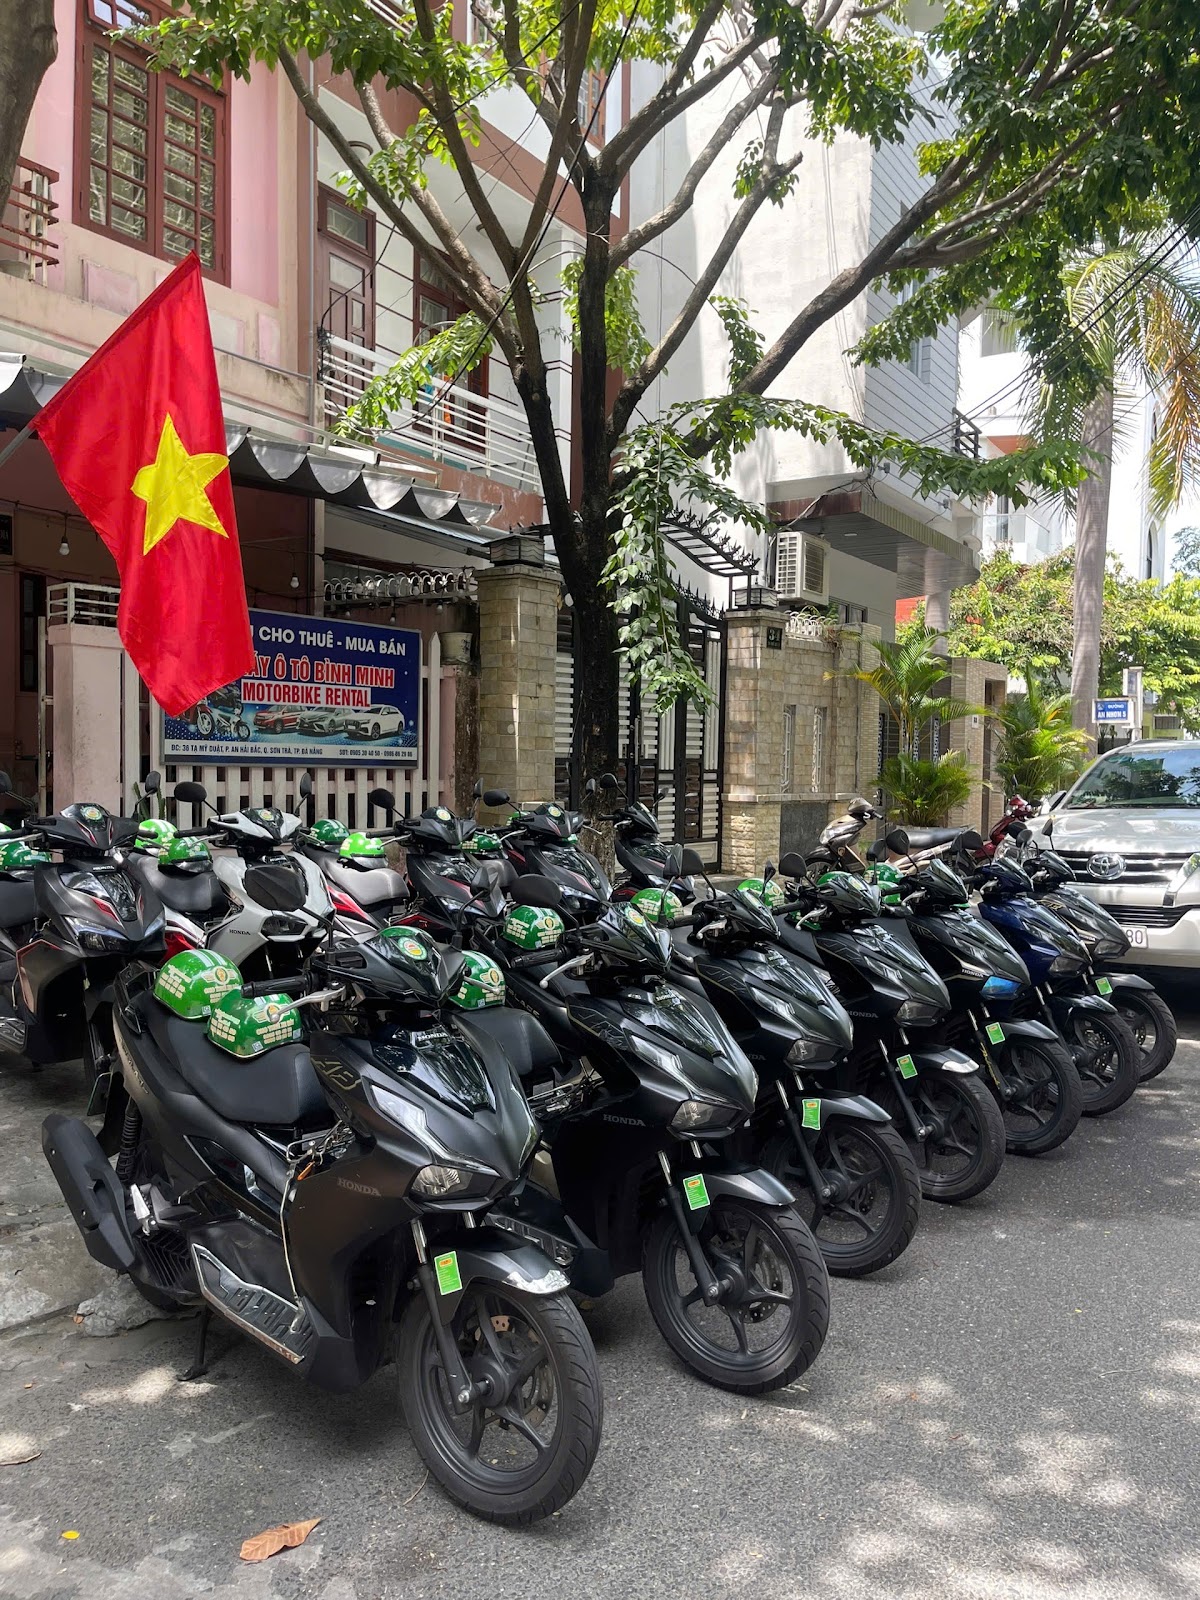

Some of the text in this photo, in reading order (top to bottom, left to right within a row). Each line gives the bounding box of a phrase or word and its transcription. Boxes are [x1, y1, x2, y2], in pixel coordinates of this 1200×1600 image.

[259, 626, 295, 643] CHO
[299, 630, 334, 648] THUÊ
[346, 636, 375, 653] MUA
[379, 638, 406, 656] BÁN
[244, 650, 395, 689] ÁY Ô TÔ BÌNH MINH
[243, 682, 371, 708] MOTORBIKE RENTAL
[1097, 711, 1106, 719] AN
[191, 744, 198, 754] TẠ
[847, 1010, 879, 1019] HONDA
[417, 1032, 448, 1042] HONDA
[603, 1113, 646, 1127] HONDA
[337, 1176, 381, 1197] HONDA
